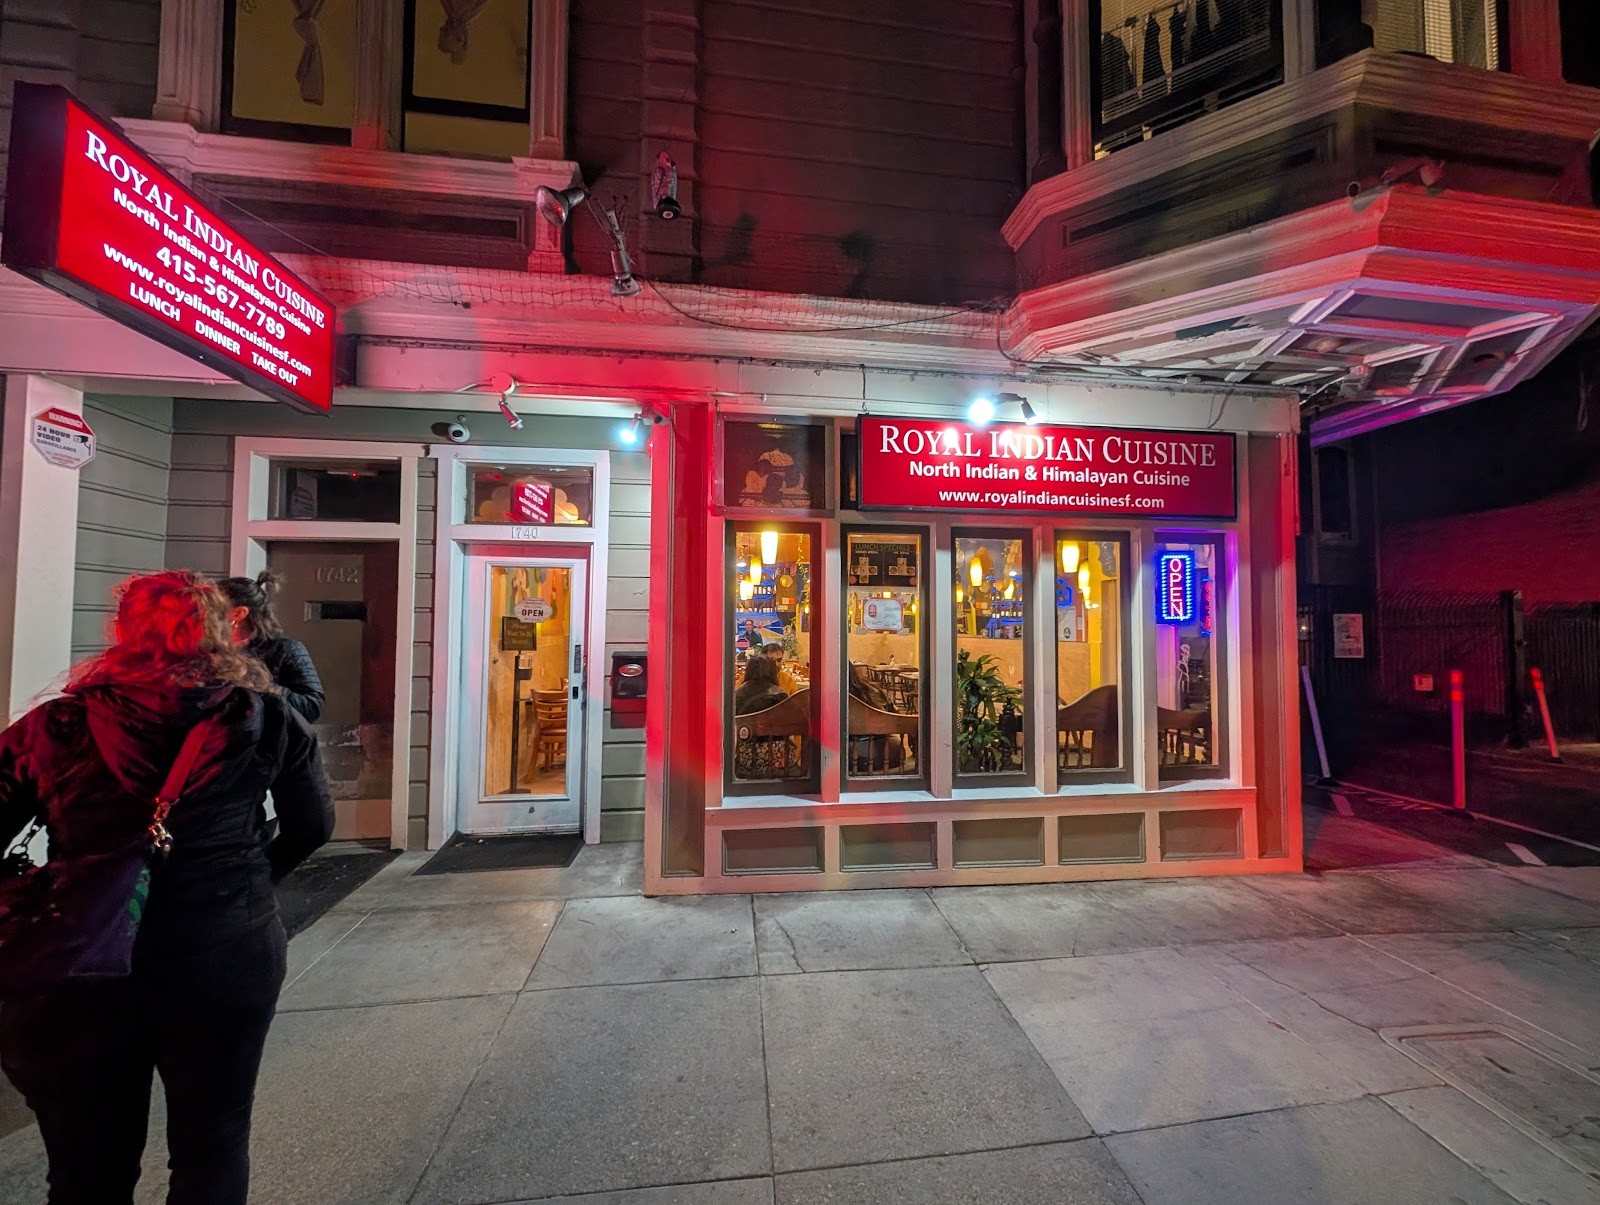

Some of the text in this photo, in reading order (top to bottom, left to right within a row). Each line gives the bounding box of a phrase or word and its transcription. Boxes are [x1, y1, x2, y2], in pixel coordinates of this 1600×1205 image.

[85, 129, 325, 329] ROYAL INDIAN CUISINE
[113, 186, 312, 336] North Indian & Himalayan Cuisine
[156, 245, 286, 341] 415-567-7789
[103, 242, 312, 377] www.royalindiancuisinesf.com
[129, 281, 299, 387] LUNCH DINNER TAKE OUT
[36, 431, 61, 443] VIDEO
[37, 425, 71, 439] 24 HOUR
[879, 424, 1217, 468] ROYAL INDIAN CUISINE
[909, 460, 1191, 488] North Indian & Himalayan Cuisine
[938, 490, 1165, 509] www.royalindiancuisinesf.com
[511, 527, 538, 539] 1740
[855, 543, 878, 551] LUNCH
[315, 567, 359, 583] 1742
[1169, 557, 1185, 621] OPEN
[521, 608, 544, 617] OPEN
